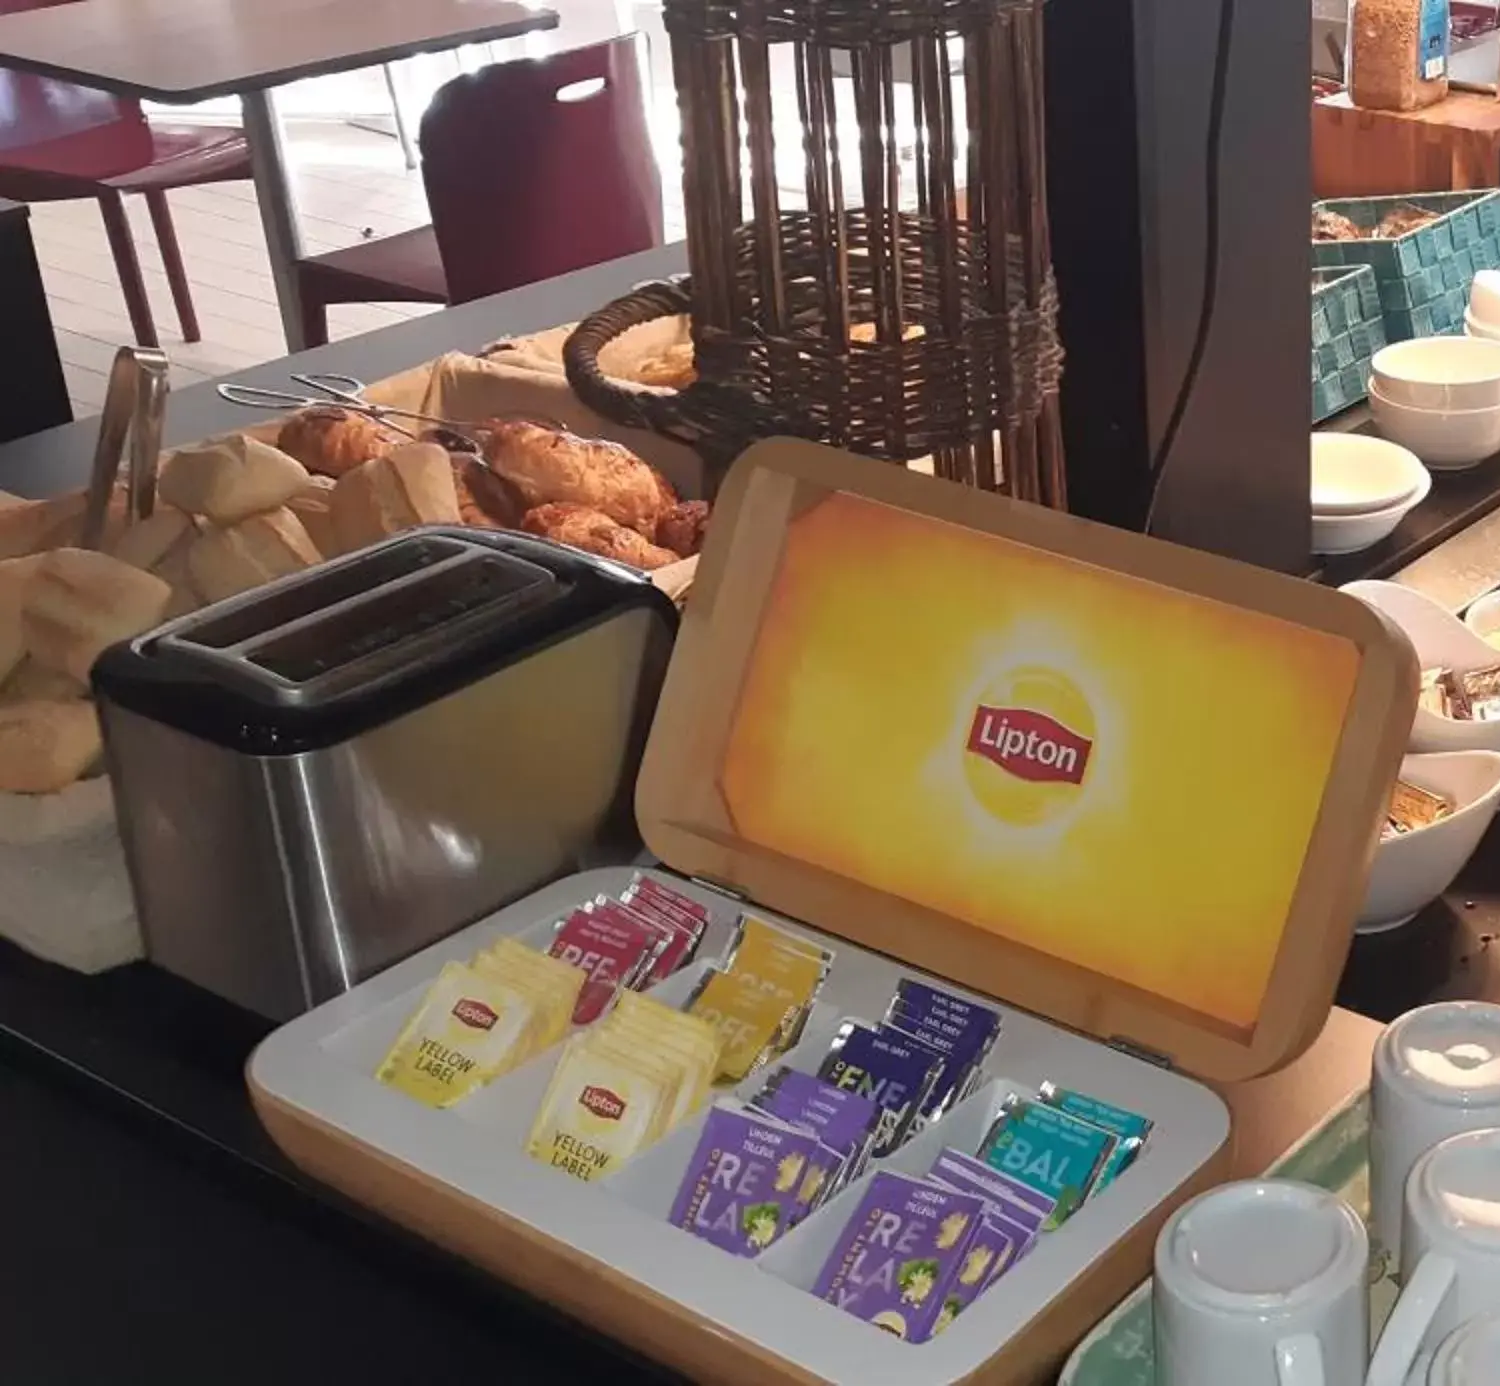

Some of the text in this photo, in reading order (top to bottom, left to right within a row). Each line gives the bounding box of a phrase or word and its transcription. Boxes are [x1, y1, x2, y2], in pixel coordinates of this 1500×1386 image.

[980, 714, 1077, 773] Lipton
[454, 1003, 493, 1027] Lipton
[414, 1056, 455, 1085] LABEL
[418, 1038, 476, 1073] YELLOW
[583, 1087, 622, 1115] Lipton
[550, 1151, 593, 1182] LABEL
[553, 1130, 610, 1168] YELLOW
[1001, 1136, 1071, 1189] BAL
[711, 1151, 767, 1196] RE
[694, 1191, 739, 1237] LA
[868, 1211, 927, 1254] RE
[846, 1249, 896, 1295] LA
